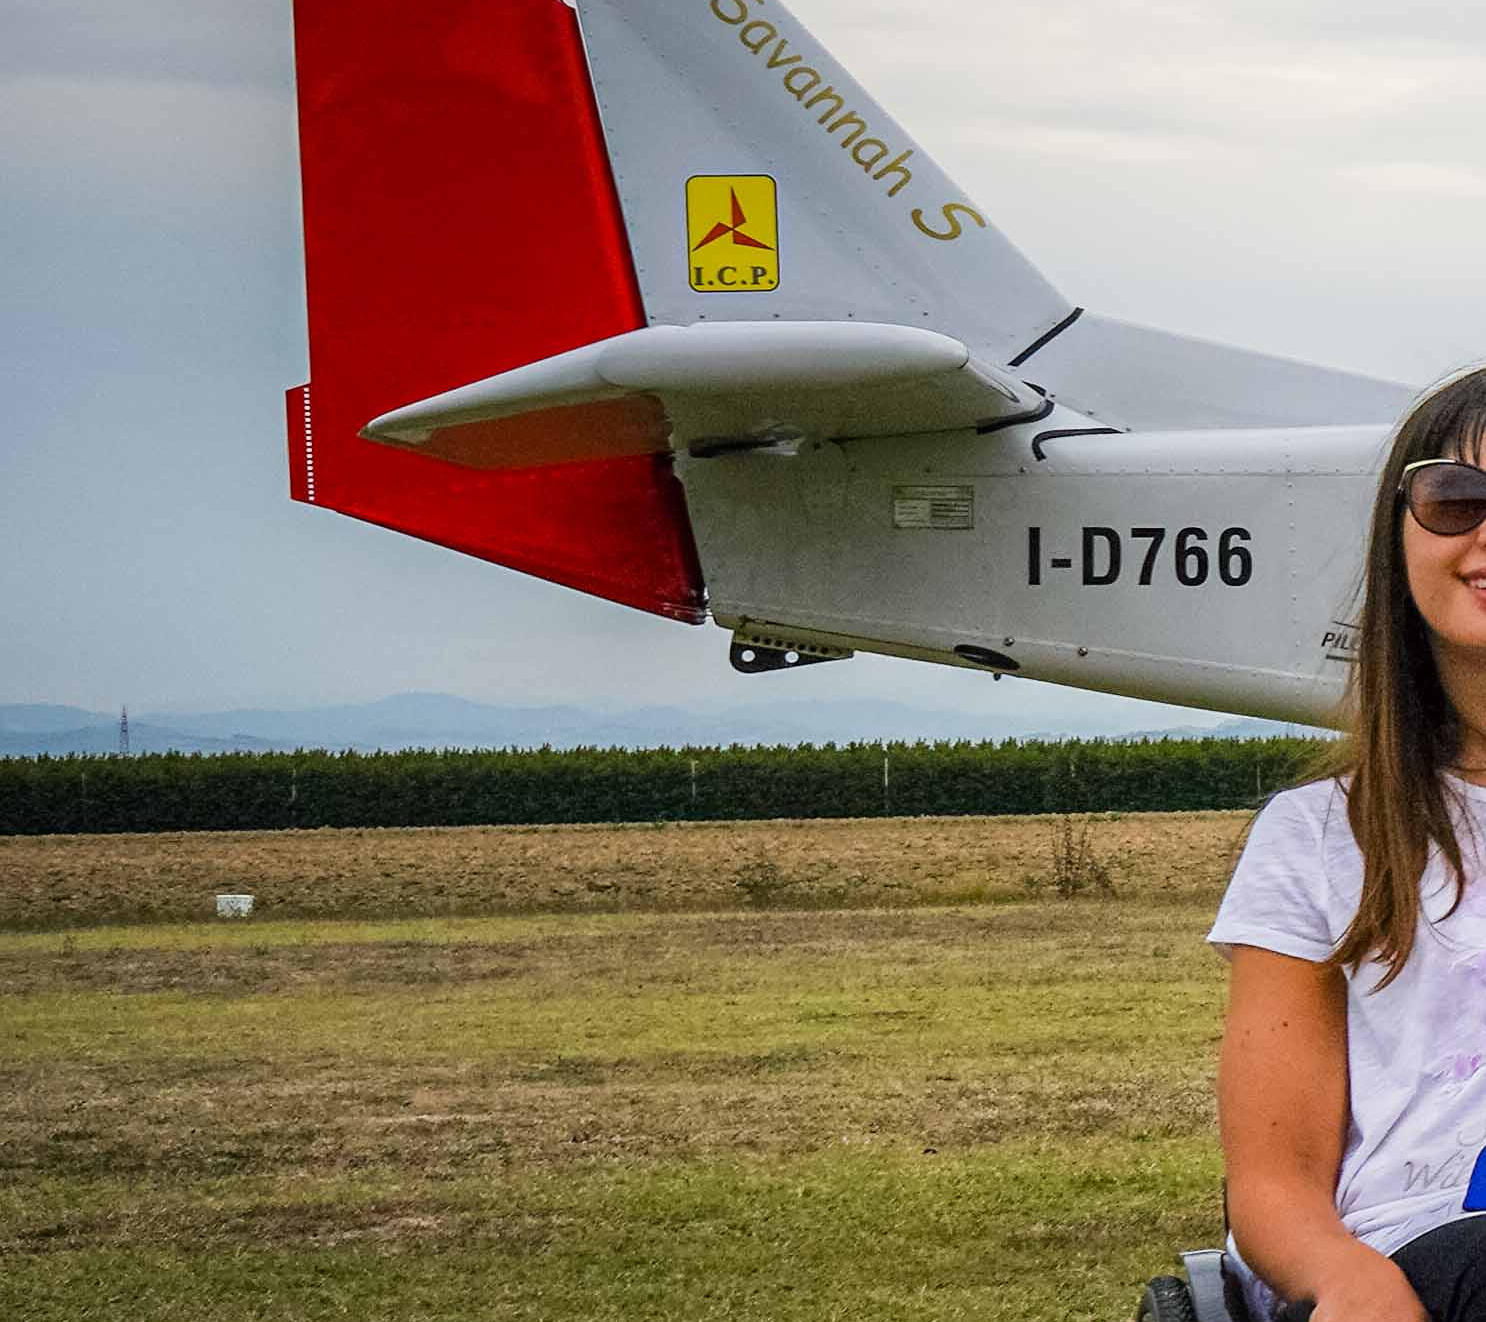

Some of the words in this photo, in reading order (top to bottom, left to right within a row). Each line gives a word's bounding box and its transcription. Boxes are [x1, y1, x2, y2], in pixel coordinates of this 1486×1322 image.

[911, 202, 987, 241] S
[693, 265, 775, 286] I.C.P.
[1027, 526, 1253, 587] I-D766
